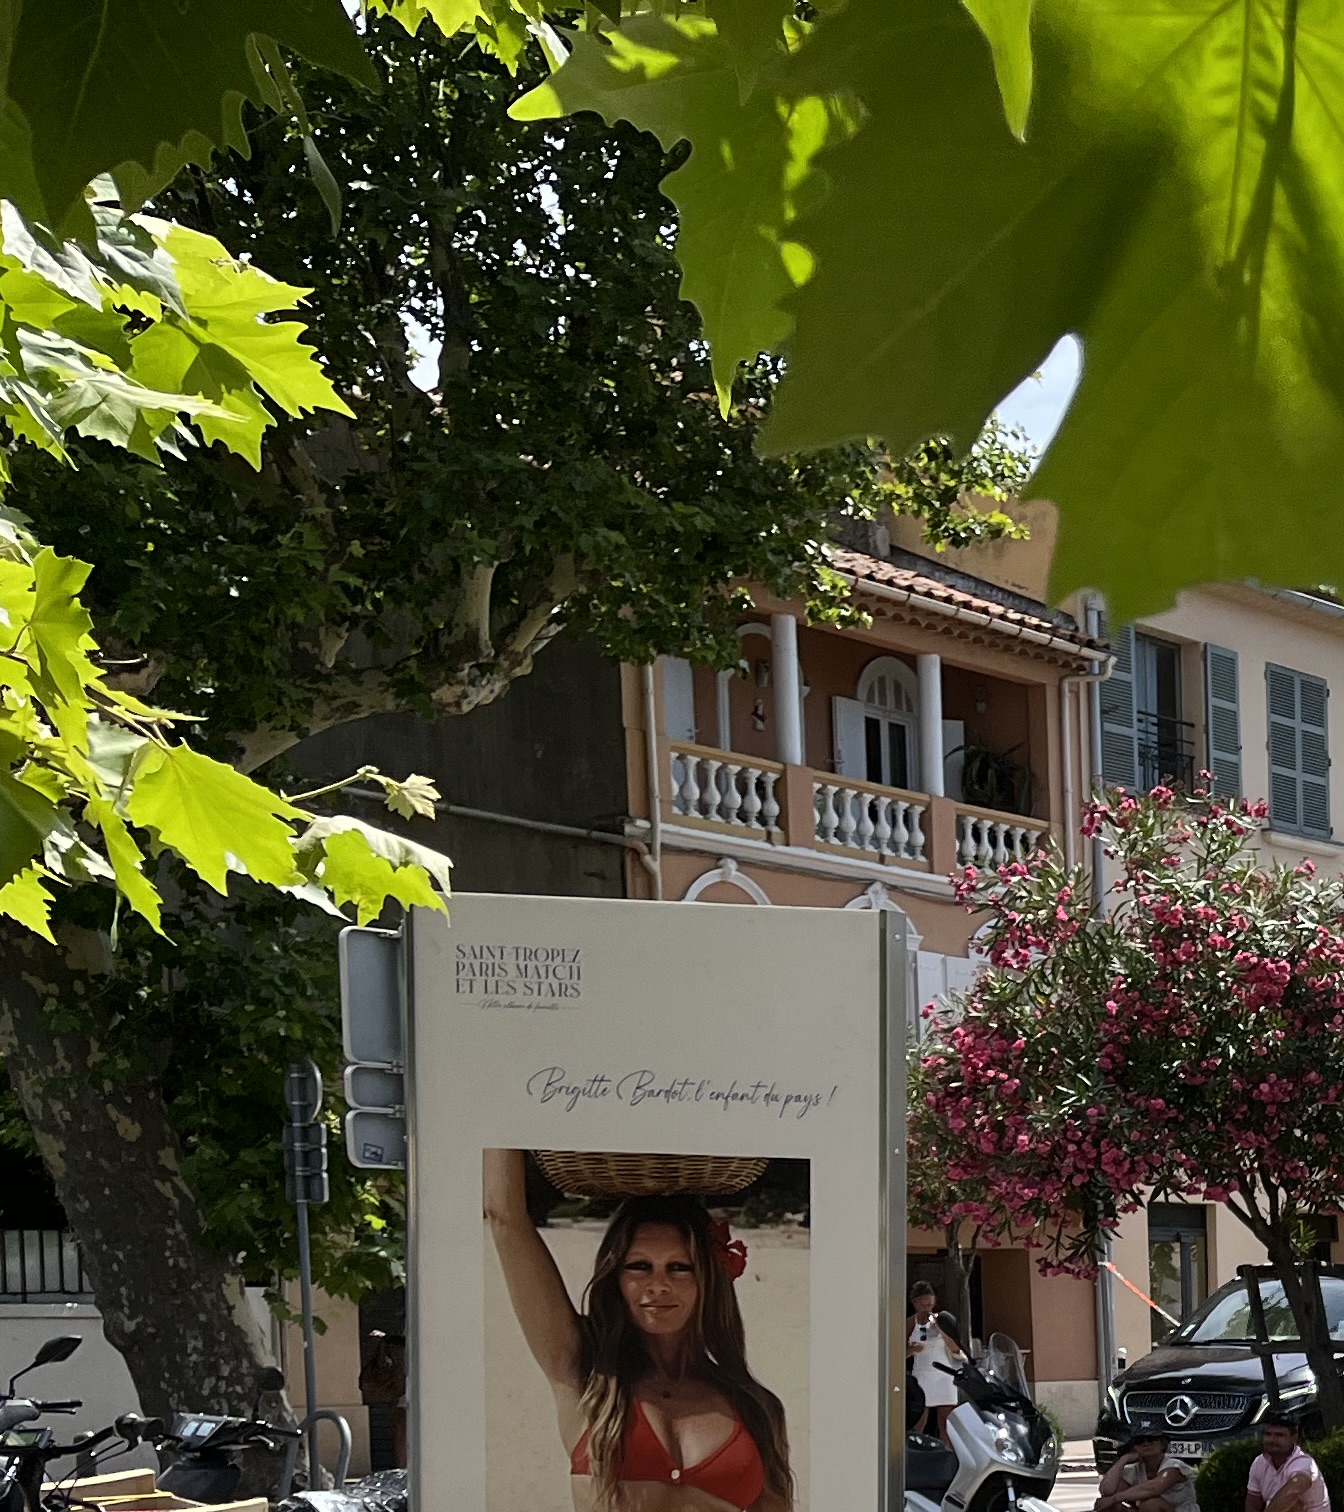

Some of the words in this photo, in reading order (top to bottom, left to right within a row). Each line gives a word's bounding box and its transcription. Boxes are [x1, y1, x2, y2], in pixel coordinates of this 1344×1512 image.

[456, 944, 580, 963] SAINT-TROPEZ
[456, 960, 508, 978] PARIS
[516, 963, 581, 981] MATCH
[456, 978, 477, 994] ET
[484, 979, 517, 995] LES
[523, 980, 581, 998] STARS
[526, 1066, 612, 1112] Brigitte
[763, 1082, 779, 1107] du
[778, 1092, 822, 1118] pays
